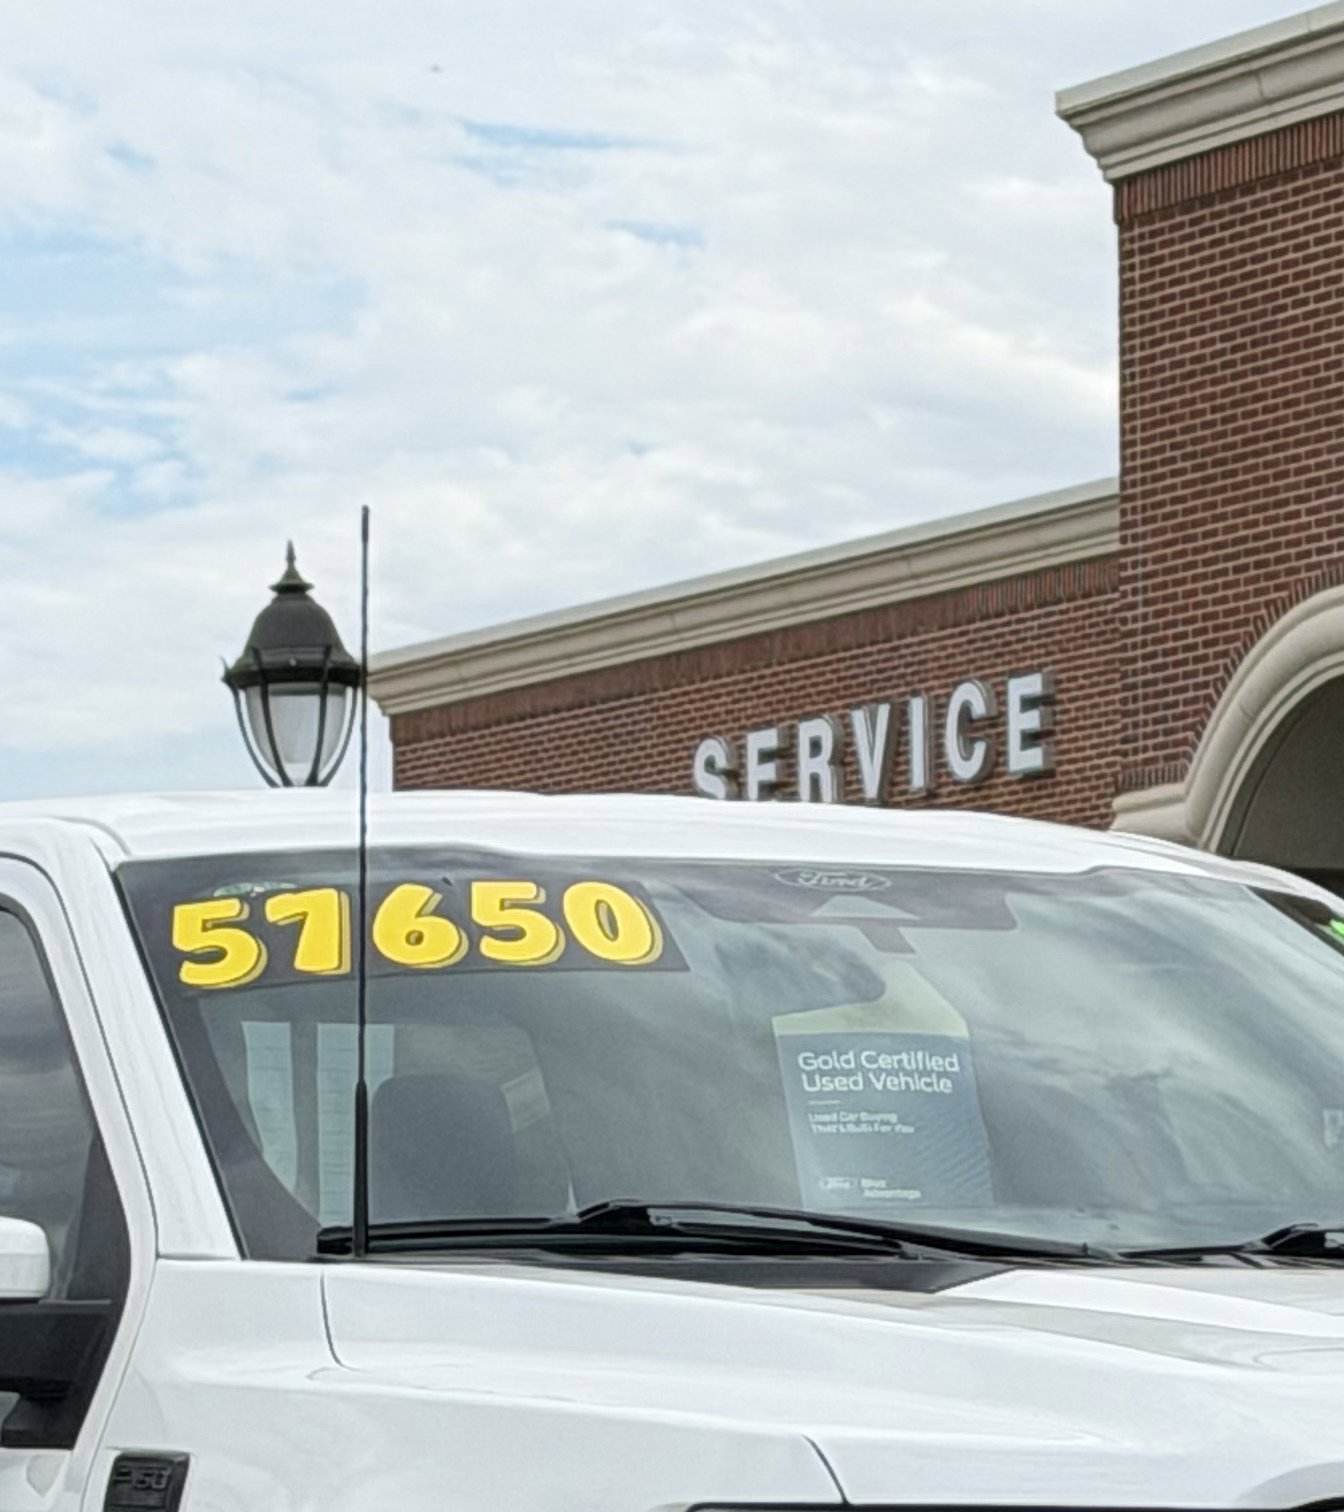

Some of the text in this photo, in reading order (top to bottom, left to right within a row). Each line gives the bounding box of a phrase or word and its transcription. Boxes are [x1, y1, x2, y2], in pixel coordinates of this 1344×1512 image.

[693, 672, 1052, 804] SERVICE
[172, 880, 663, 990] 57650
[798, 1050, 960, 1073] Gold Certified
[802, 1070, 953, 1093] Used Vehicle
